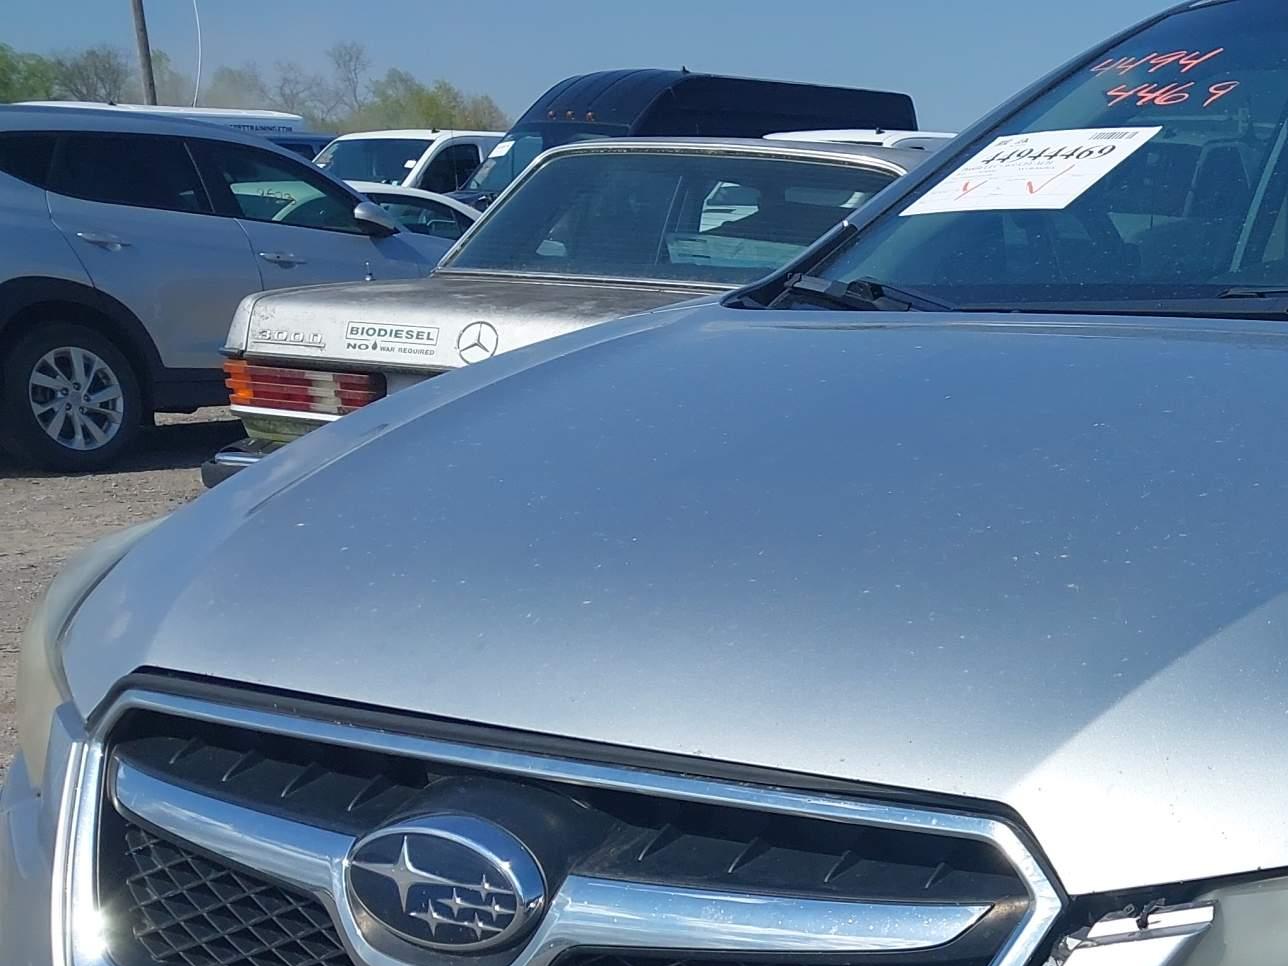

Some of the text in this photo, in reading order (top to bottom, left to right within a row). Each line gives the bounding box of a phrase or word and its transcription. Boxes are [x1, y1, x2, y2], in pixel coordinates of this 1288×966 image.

[1090, 47, 1224, 77] 4494
[981, 144, 1117, 165] 44944469
[349, 325, 435, 342] BIODIESEL
[346, 342, 370, 351] NO
[397, 346, 435, 356] REQUIRED
